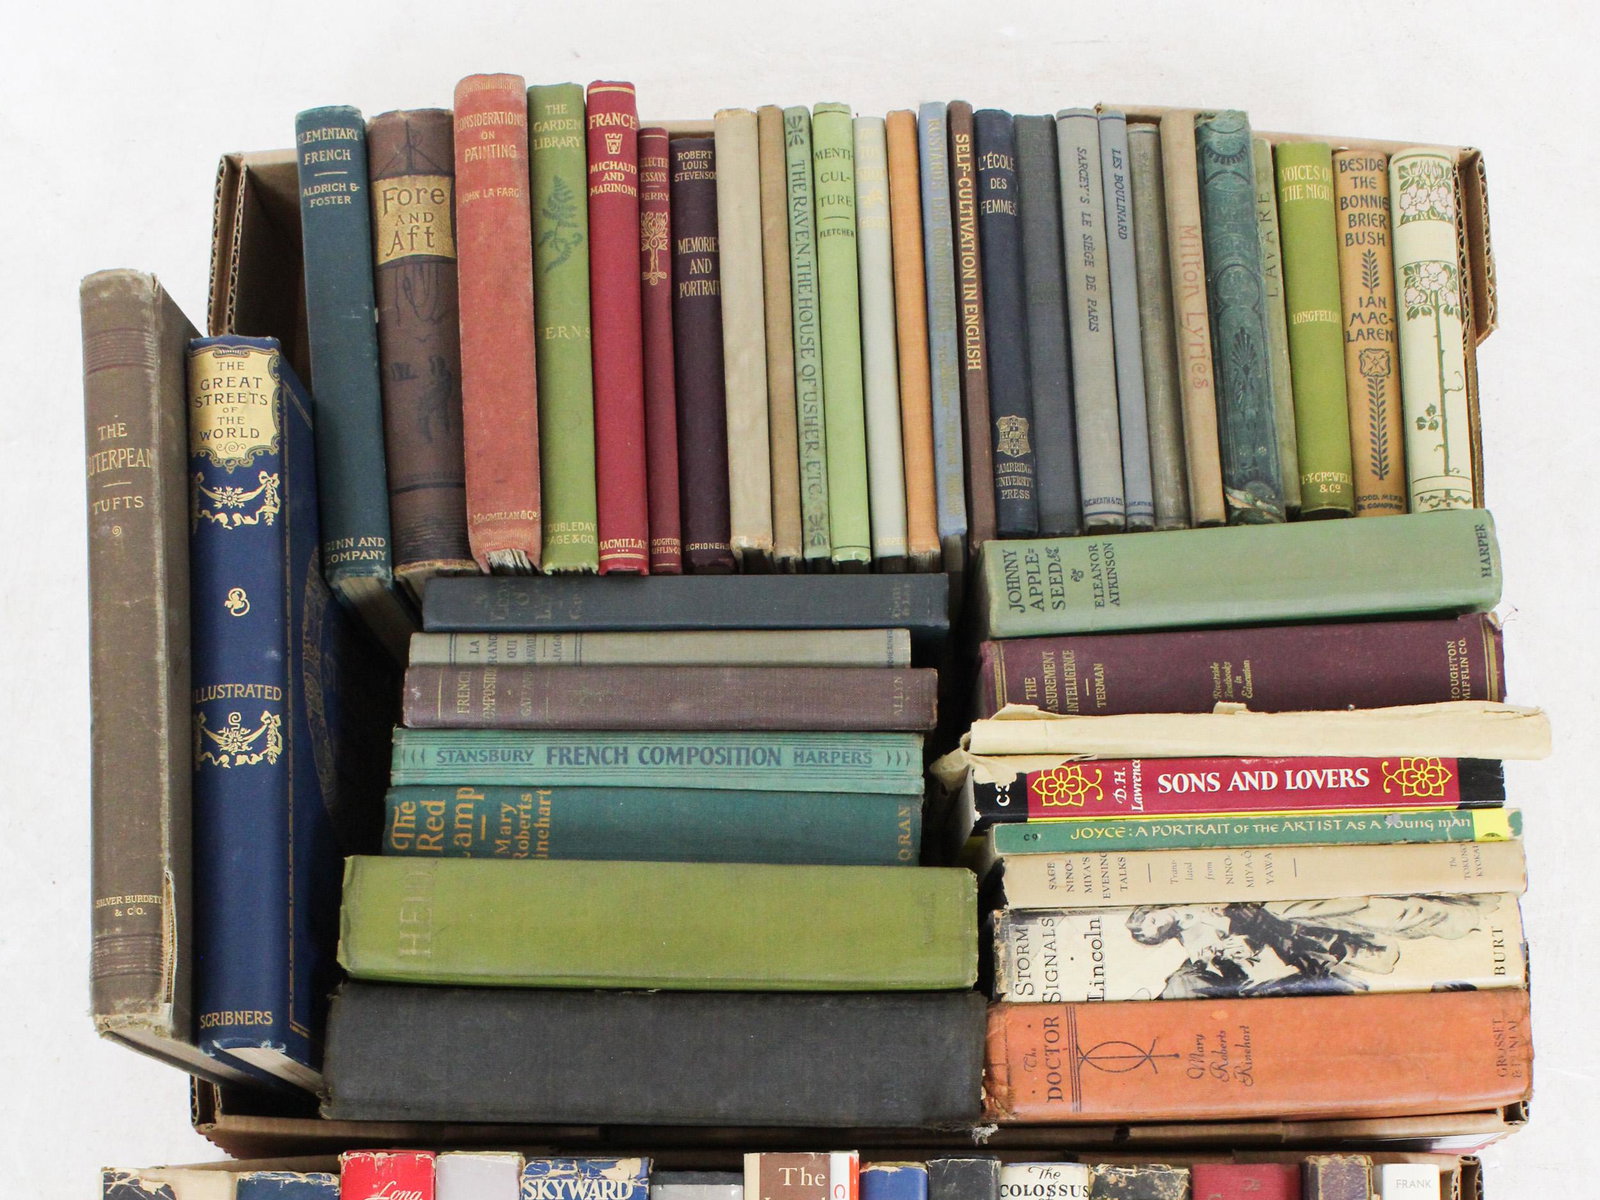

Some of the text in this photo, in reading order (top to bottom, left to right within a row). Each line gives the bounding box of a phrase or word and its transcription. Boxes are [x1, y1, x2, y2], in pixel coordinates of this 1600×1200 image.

[545, 104, 568, 114] THE
[589, 112, 636, 130] FRANCE
[534, 136, 581, 150] LIBRARY
[304, 149, 351, 165] FRENCH
[677, 151, 713, 161] ROBERT
[590, 161, 637, 174] MICHAUD
[682, 161, 708, 170] LOUIS
[1339, 158, 1384, 173] BESIDE
[602, 172, 624, 182] AND
[991, 178, 1007, 189] DES
[1077, 146, 1090, 205] SARCEY'S
[1351, 176, 1377, 190] THE
[310, 196, 351, 207] FOSTER
[382, 186, 446, 218] Fore
[1111, 148, 1128, 240] LES BOULINARD
[1081, 211, 1092, 227] LE
[1348, 213, 1387, 229] BRIER
[385, 225, 436, 257] Aft
[820, 229, 854, 238] FLETCHER
[1345, 231, 1386, 247] BUSH
[955, 134, 981, 370] SELF-CULTIVATION IN ENGLISH
[689, 258, 712, 274] AND
[1086, 274, 1097, 292] DE
[1178, 225, 1209, 390] Milton Lyrics
[1359, 296, 1387, 309] IAN
[1087, 298, 1099, 332] PARIS
[216, 361, 245, 371] THE
[200, 377, 263, 391] GREAT
[194, 392, 268, 408] STREETS
[217, 416, 245, 425] THE
[98, 423, 128, 441] THE
[200, 428, 260, 441] WORLD
[92, 496, 144, 516] TUFTS
[1003, 549, 1026, 614] JOHNNY
[1088, 544, 1105, 609] ELEANOR
[1103, 542, 1120, 607] ATKINSON
[1024, 677, 1038, 700] THE
[1093, 663, 1106, 708] TERMAN
[436, 746, 873, 766] STANSBURY FRENCH COMPOSITION HARPERS
[1158, 767, 1370, 794] SONS AND LOVERS
[391, 801, 417, 850] The
[416, 799, 446, 851] Red
[1136, 826, 1149, 837] A
[1152, 823, 1231, 837] PORTRAIT
[1234, 825, 1249, 834] OF
[1252, 824, 1279, 833] THE
[1282, 820, 1344, 832] ARTIST
[1347, 821, 1366, 831] AS
[1369, 820, 1382, 830] A
[1120, 857, 1128, 891] TALKS
[1042, 917, 1062, 1004] SIGNALS
[1084, 918, 1106, 1002] Lincoln
[1492, 928, 1506, 976] BURT
[1015, 927, 1035, 996] STORM
[1043, 1016, 1064, 1103] DOCTOR
[779, 1167, 826, 1187] The
[524, 1179, 634, 1200] SKYWARD
